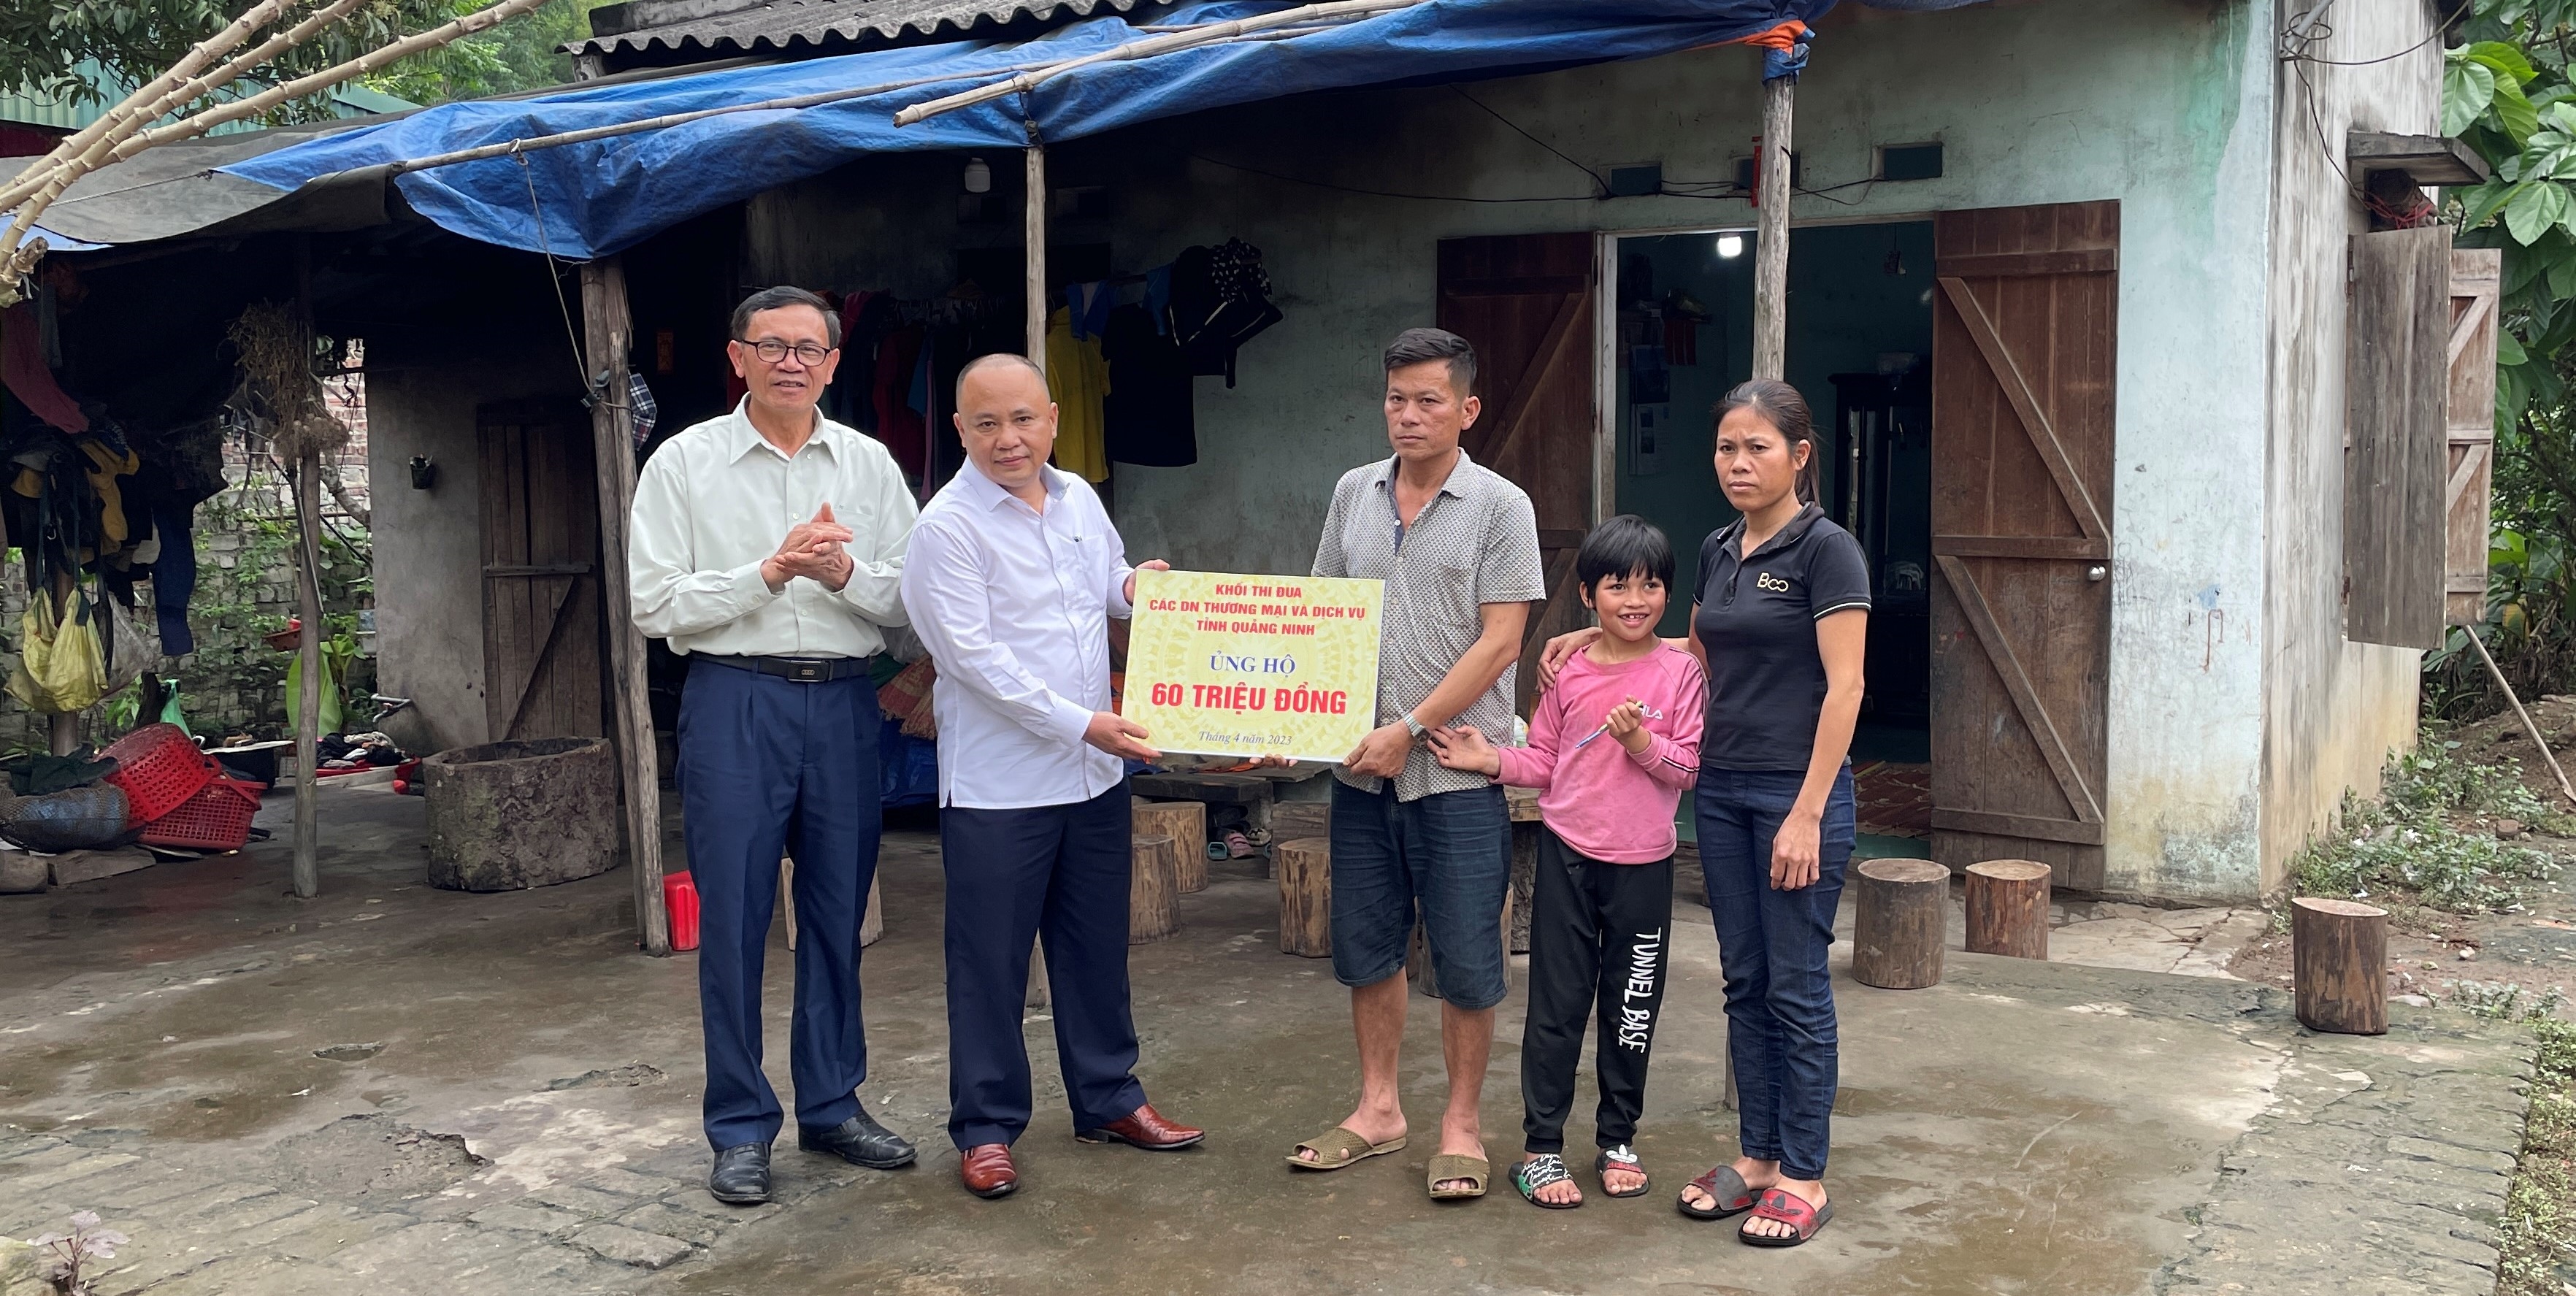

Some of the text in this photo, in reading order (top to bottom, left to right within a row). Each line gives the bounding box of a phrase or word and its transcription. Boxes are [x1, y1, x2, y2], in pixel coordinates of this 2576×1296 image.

[1215, 582, 1302, 599] KHỐI THI ĐUA
[1149, 598, 1366, 621] CÁC DN THƯƠNG MẠI VÀ DỊCH VỤ
[1197, 617, 1316, 637] TỈNH QUẢNG NINH
[1210, 650, 1296, 678] ỦNG HỘ
[1151, 680, 1347, 716] 60 TRIỆU ĐỒNG
[1638, 704, 1664, 721] ILA
[1198, 731, 1292, 746] Tháng 4 năm 2023
[1618, 926, 1661, 1054] TUNNEL BASE
